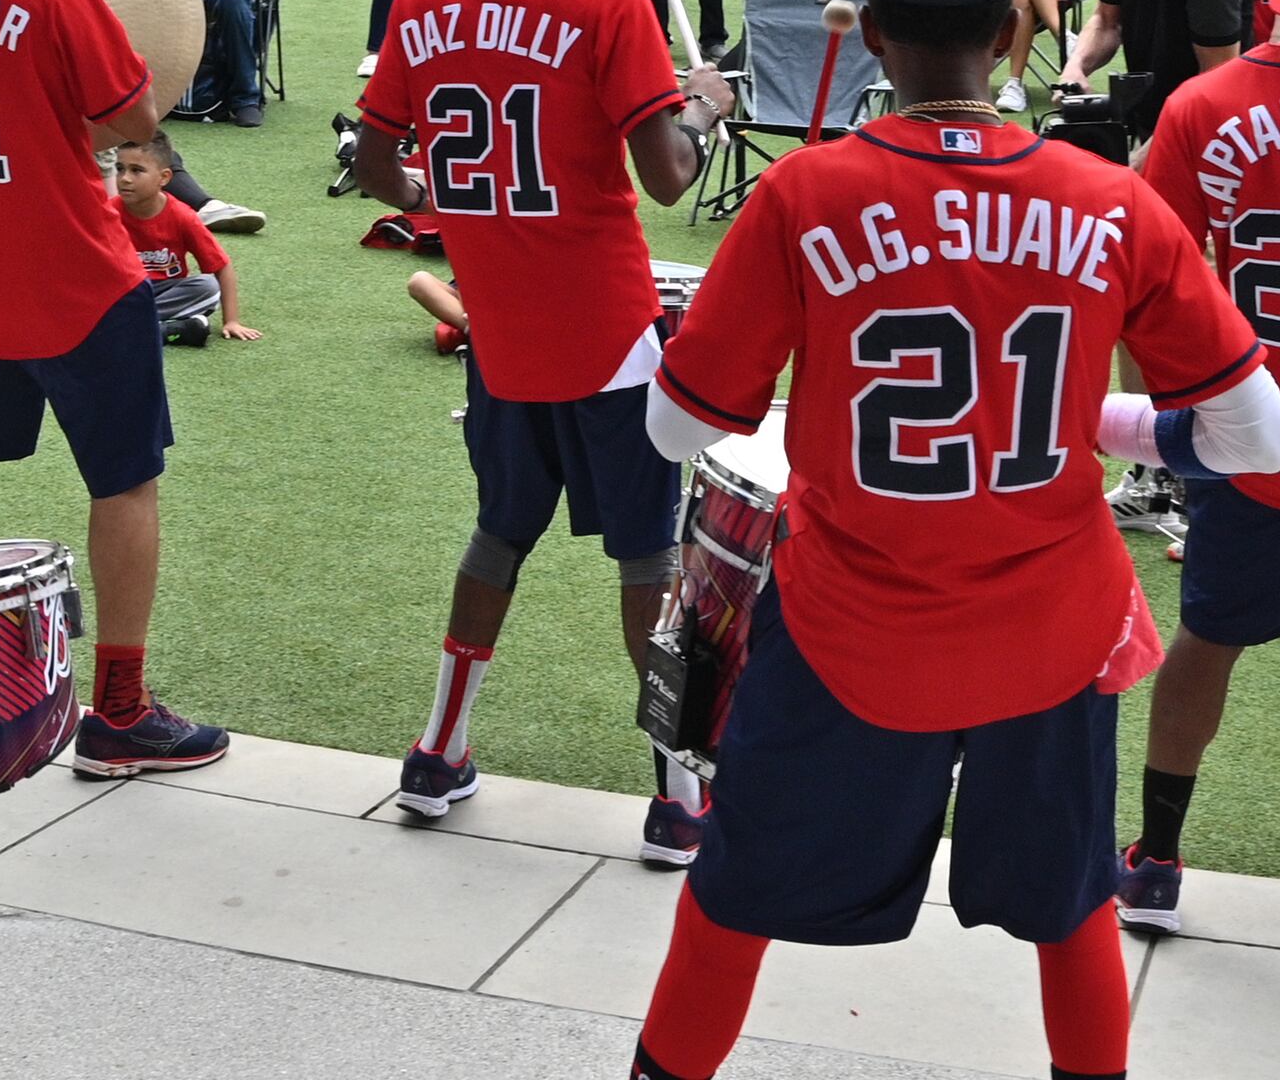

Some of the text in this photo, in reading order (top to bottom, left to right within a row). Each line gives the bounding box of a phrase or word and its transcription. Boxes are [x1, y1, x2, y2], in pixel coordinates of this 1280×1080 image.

[399, 2, 582, 69] DAZ DILLY
[425, 83, 559, 217] 21
[850, 304, 1073, 502] 21
